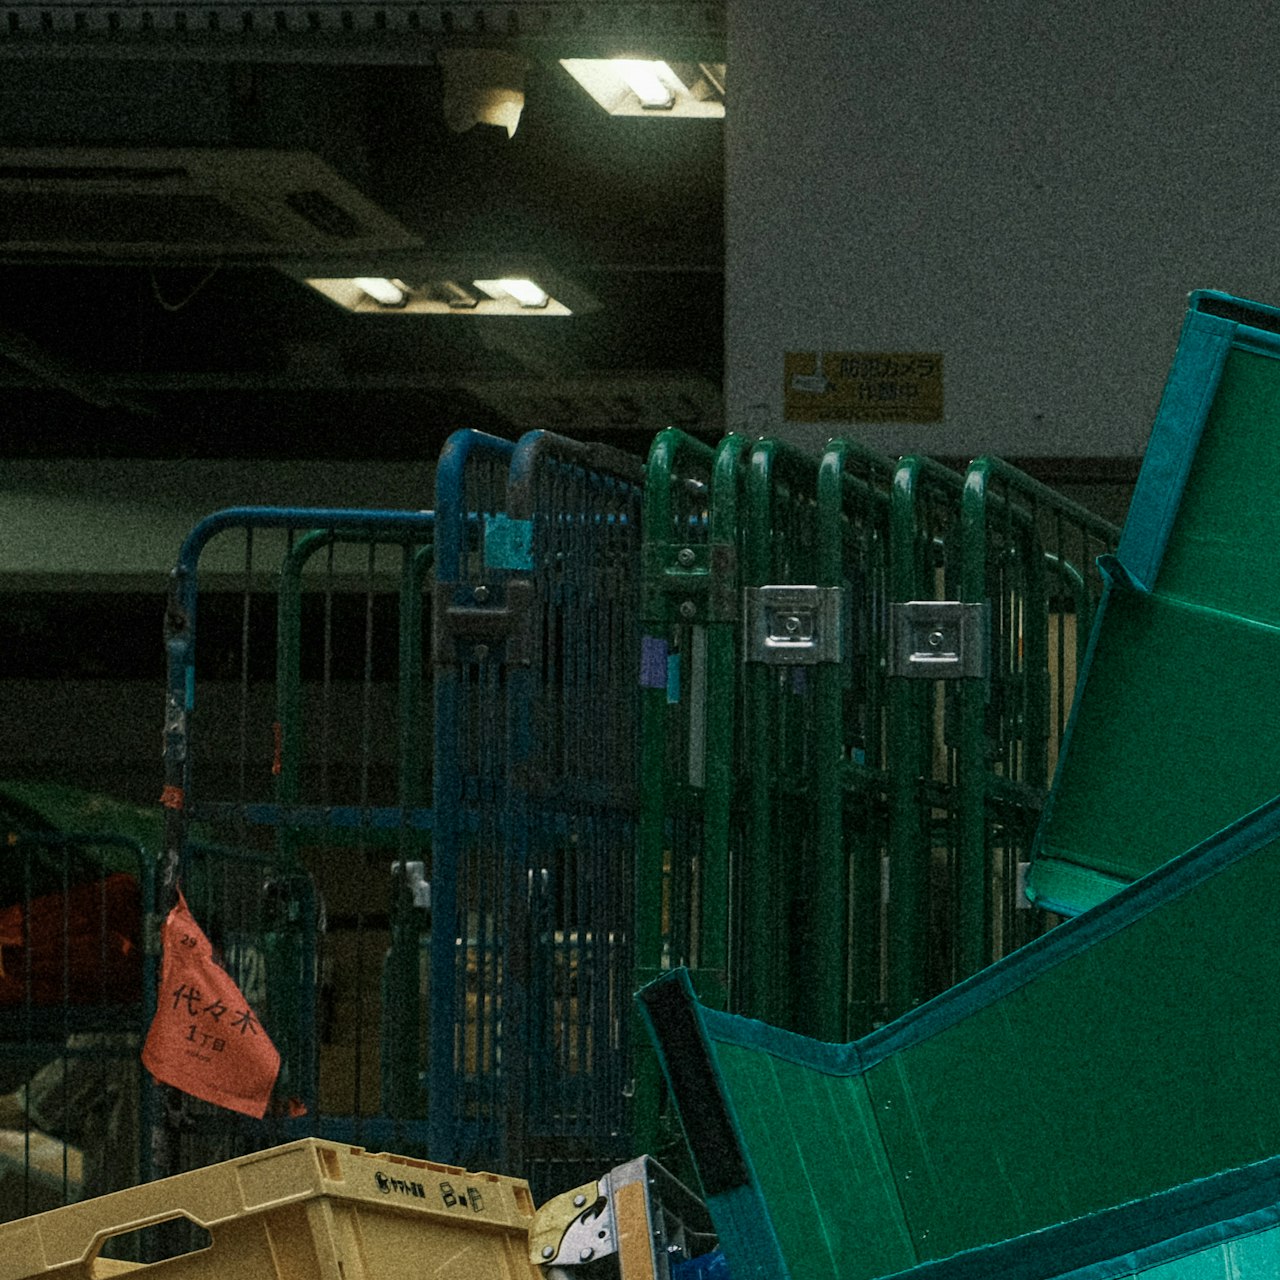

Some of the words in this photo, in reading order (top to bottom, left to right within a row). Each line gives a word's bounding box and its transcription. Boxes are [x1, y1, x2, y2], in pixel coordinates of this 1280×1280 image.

[180, 933, 198, 949] 29
[172, 983, 258, 1036] 代々木
[186, 1024, 227, 1053] 1丁目
